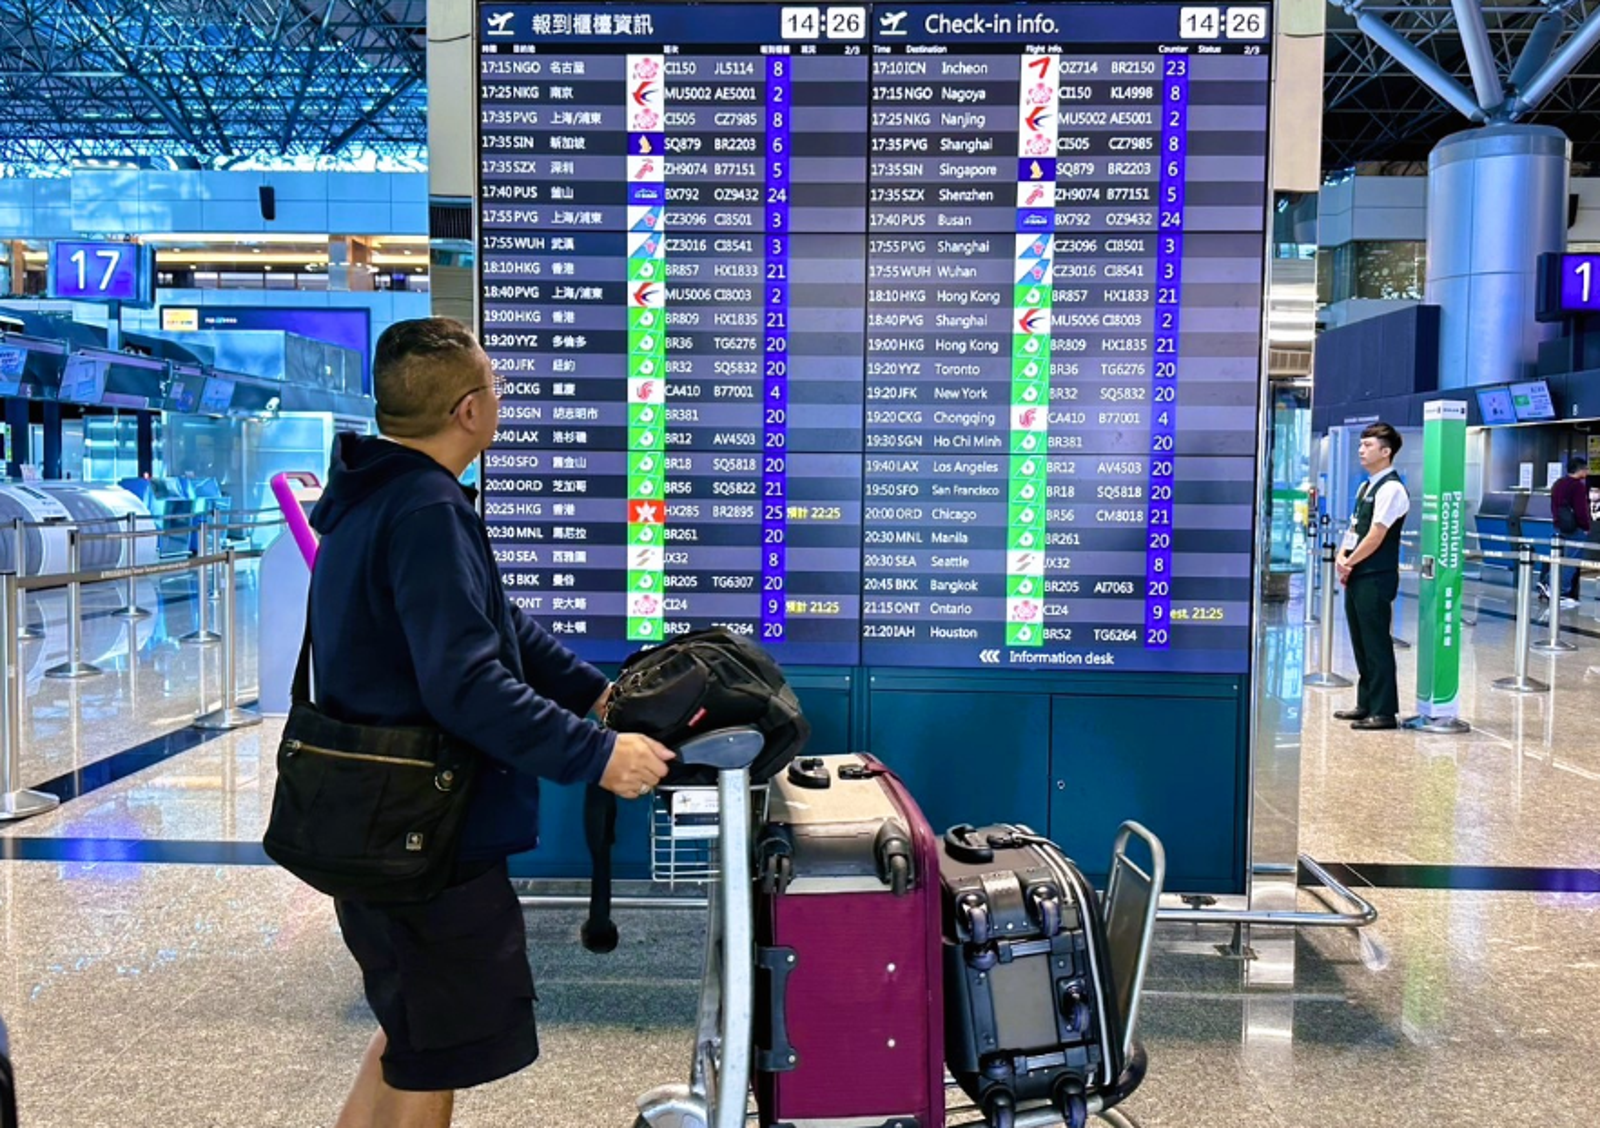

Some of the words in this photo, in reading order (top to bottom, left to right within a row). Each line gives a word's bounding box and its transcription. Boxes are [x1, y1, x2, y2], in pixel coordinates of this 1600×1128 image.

[789, 14, 859, 32] 14:26
[925, 13, 1011, 33] Check-in
[1017, 13, 1059, 33] info.
[1188, 14, 1259, 32] 14:26
[873, 45, 891, 53] Time
[906, 45, 947, 53] Destination
[1026, 45, 1046, 55] Flight
[1158, 45, 1188, 53] Counter
[1198, 45, 1221, 53] Status
[482, 61, 511, 73] 17:15
[513, 62, 541, 73] NGO
[715, 62, 753, 74] JL5114
[774, 61, 783, 76] 8
[873, 62, 903, 74] 17:10
[905, 62, 926, 74] ICN
[942, 61, 987, 74] Incheon
[1060, 62, 1098, 74] OZ714
[1112, 62, 1155, 73] BR2150
[1166, 61, 1185, 75] 23
[482, 86, 512, 98] 17:25
[513, 86, 539, 98] NKG
[664, 87, 711, 100] MU5002
[714, 87, 756, 100] AE5001
[774, 86, 782, 102] 2
[873, 87, 903, 100] 17:15
[905, 87, 932, 100] NGO
[942, 87, 986, 102] Nagoya
[1111, 87, 1153, 99] KL4998
[1170, 86, 1180, 100] 8
[482, 111, 511, 123] 17:35
[514, 112, 537, 123] PVG
[714, 113, 757, 125] CZ7985
[773, 112, 782, 127] 8
[873, 113, 902, 125] 17:25
[904, 113, 930, 125] NKG
[941, 113, 985, 128] Nanjing
[1058, 112, 1106, 124] MU5002
[1110, 112, 1152, 124] AE5001
[1170, 111, 1179, 126] 2
[482, 136, 512, 148] 17:35
[513, 136, 534, 148] SIN
[664, 138, 701, 152] SQ879
[715, 138, 756, 150] BR2203
[773, 137, 782, 152] 6
[872, 138, 902, 151] 17:35
[903, 138, 927, 150] PVG
[940, 138, 992, 153] Shanghai
[1108, 137, 1152, 149] CZ7985
[1169, 136, 1178, 151] 8
[871, 163, 901, 176] 17:35
[903, 164, 923, 175] SIN
[939, 163, 997, 178] Singapore
[1057, 163, 1094, 177] SQ879
[1108, 163, 1151, 174] BR2203
[1168, 161, 1178, 176] 6
[871, 189, 900, 201] 17:35
[902, 189, 924, 201] SZX
[939, 189, 993, 201] Shenzhen
[1056, 188, 1100, 200] ZH9074
[1107, 188, 1149, 200] B77151
[1168, 187, 1176, 202] 5
[870, 214, 900, 226] 17:40
[902, 214, 925, 225] PUS
[938, 214, 971, 226] Busan
[1055, 213, 1091, 225] BX792
[1106, 213, 1151, 225] OZ9432
[1161, 212, 1180, 227] 24
[71, 250, 119, 290] 17
[484, 261, 513, 273] 18:10
[515, 262, 540, 274] HKG
[715, 265, 758, 276] HX1833
[767, 264, 786, 278] 21
[870, 266, 899, 277] 17:55
[901, 266, 931, 277] WUH
[937, 266, 976, 278] Wuhan
[1054, 265, 1096, 277] CZ3016
[1104, 265, 1143, 276] CI8541
[1164, 263, 1173, 278] 3
[484, 333, 514, 347] 19:20
[514, 335, 537, 346] YYZ
[714, 337, 757, 349] TG6276
[767, 337, 786, 352] 20
[868, 363, 899, 374] 19:20
[899, 363, 920, 374] YYZ
[935, 363, 980, 375] Toronto
[1101, 364, 1145, 375] TG6276
[1156, 363, 1175, 377] 20
[486, 455, 515, 467] 19:50
[516, 456, 538, 467] SFO
[713, 458, 756, 472] SQ5818
[765, 458, 784, 472] 20
[485, 479, 515, 490] 20:00
[515, 480, 543, 491] ORD
[713, 482, 756, 495] SQ5822
[765, 482, 782, 495] 21
[486, 503, 514, 514] 20:25
[517, 504, 541, 515] HKG
[664, 505, 699, 517] HX285
[713, 506, 753, 517] BR2895
[765, 505, 783, 519] 25
[808, 507, 840, 519] 22:25
[865, 508, 897, 519] 20:00
[897, 508, 922, 519] ORD
[932, 508, 977, 523] Chicago
[1096, 510, 1143, 521] CM8018
[1151, 509, 1168, 524] 21
[1439, 492, 1452, 568] Economy
[1451, 491, 1462, 569] Premium
[864, 578, 896, 590] 20:45
[896, 578, 918, 590] BKK
[931, 579, 978, 593] Bangkok
[1094, 582, 1134, 593] AI7063
[1149, 582, 1168, 595] 20
[864, 602, 896, 613] 21:15
[896, 602, 920, 613] ONT
[930, 602, 972, 614] Ontario
[1153, 605, 1162, 619] 9
[1192, 607, 1223, 619] 21:25
[863, 625, 896, 637] 21:20
[896, 626, 915, 637] IAH
[930, 627, 978, 638] Houston
[1094, 629, 1137, 641] TG6264
[1148, 629, 1167, 644] 20
[1010, 651, 1082, 664] Information
[1085, 652, 1114, 664] desk
